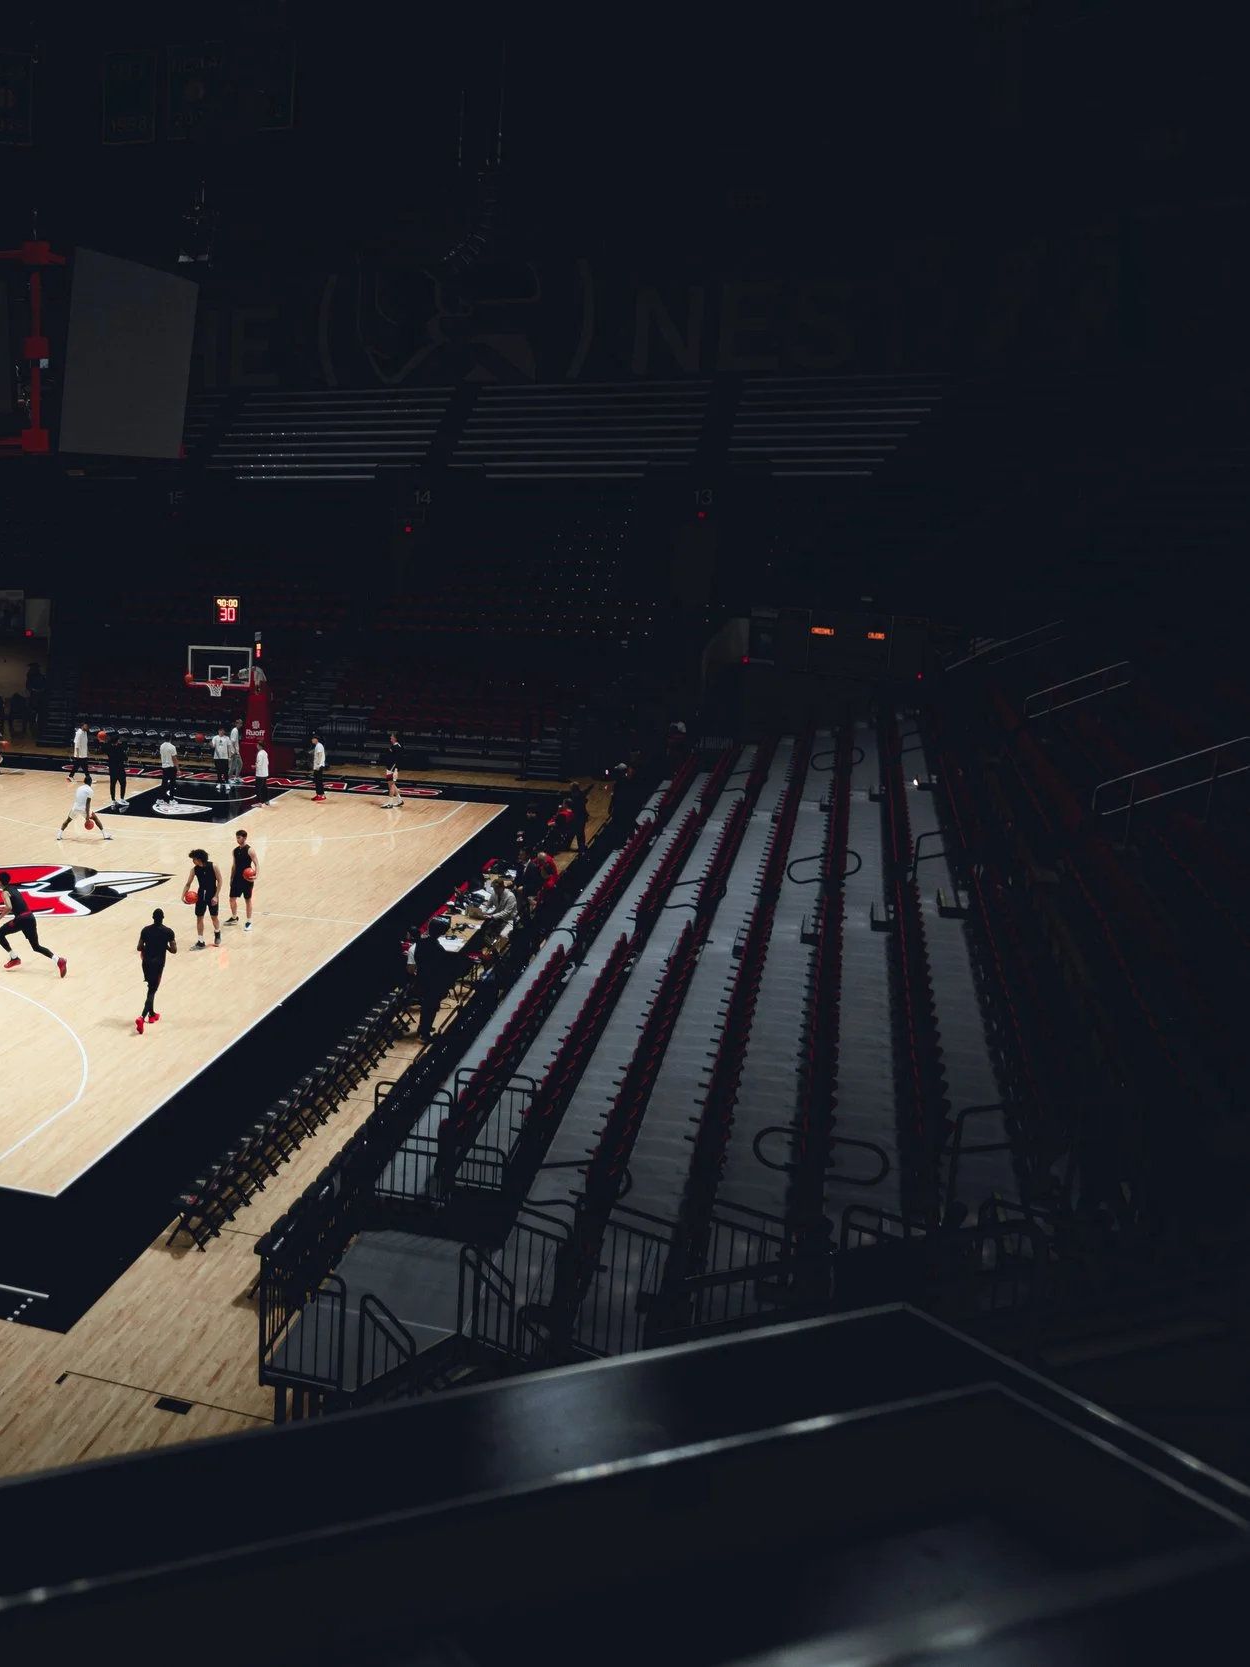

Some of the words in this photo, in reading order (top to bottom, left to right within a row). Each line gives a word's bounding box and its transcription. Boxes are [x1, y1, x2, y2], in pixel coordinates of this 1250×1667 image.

[216, 599, 238, 607] 90:00
[220, 607, 236, 622] 30
[246, 729, 265, 737] Ruoff
